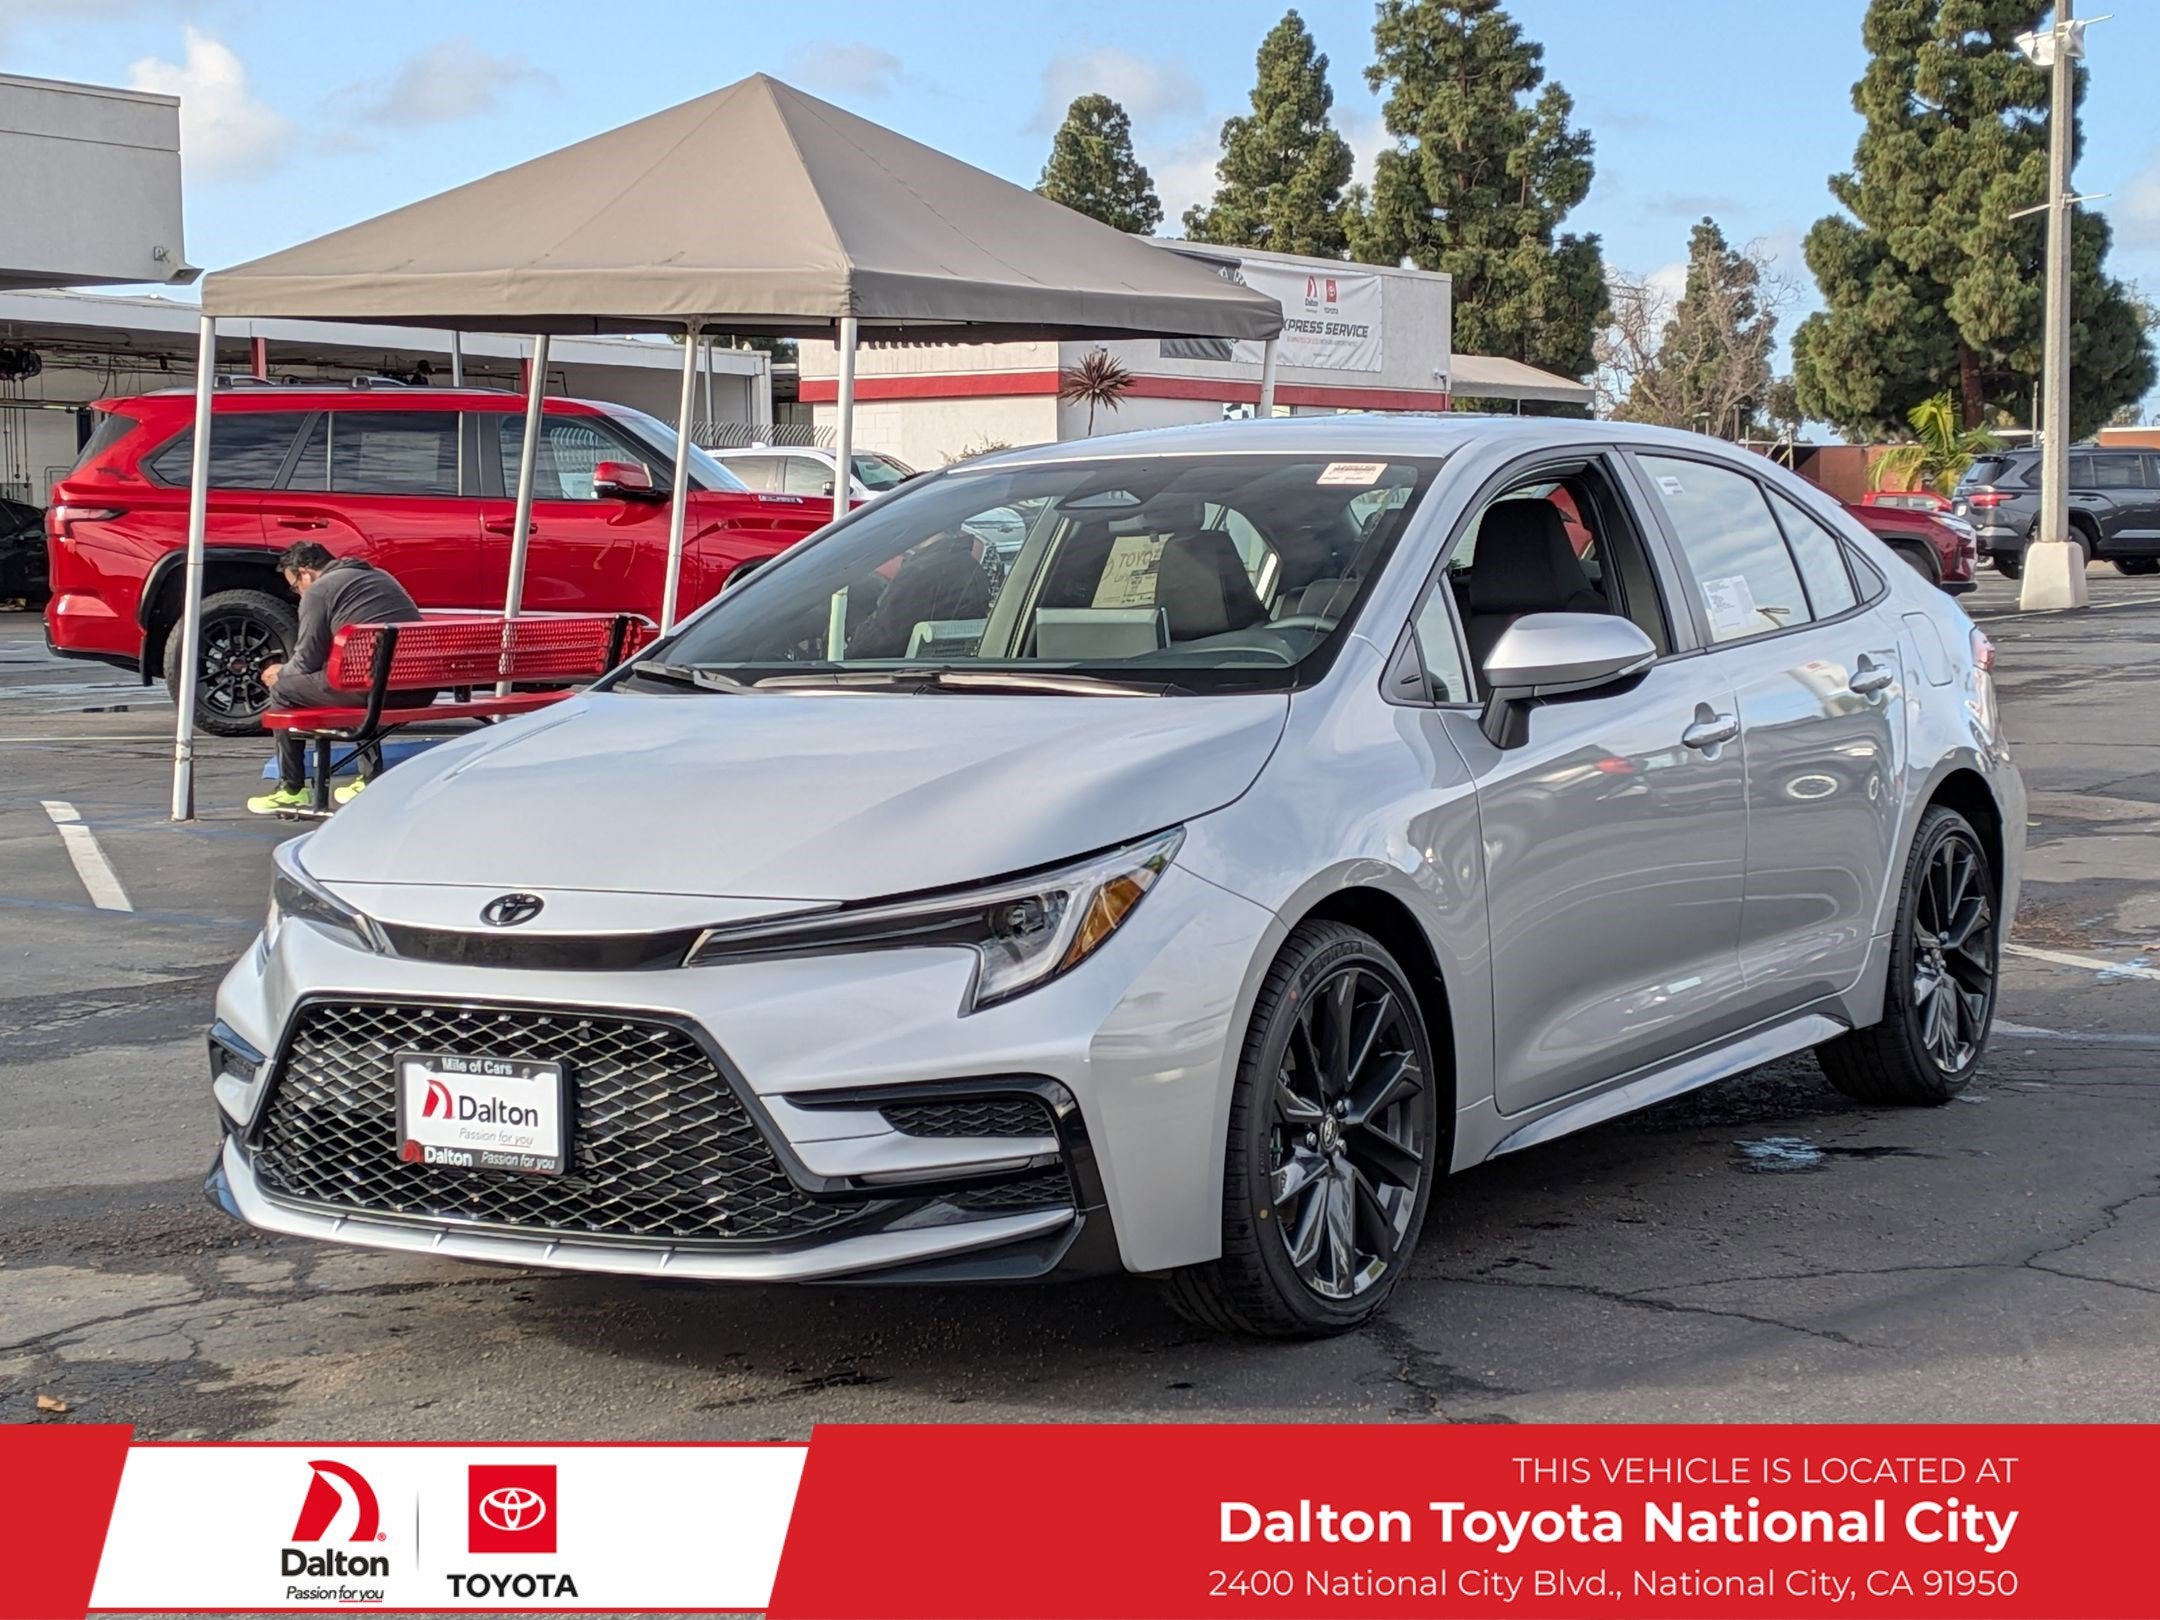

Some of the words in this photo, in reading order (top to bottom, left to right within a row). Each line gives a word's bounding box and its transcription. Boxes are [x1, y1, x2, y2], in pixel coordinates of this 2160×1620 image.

[1283, 318, 1324, 334] XPRESS
[1325, 322, 1369, 338] SERVICE
[1120, 550, 1158, 568] TOYO
[442, 1057, 467, 1073] Mile
[469, 1058, 483, 1073] of
[484, 1060, 513, 1075] Cars
[458, 1095, 539, 1127] Dalton
[459, 1128, 497, 1143] Passion
[498, 1130, 514, 1144] for
[514, 1133, 534, 1146] you
[424, 1146, 473, 1167] Dalton
[481, 1151, 519, 1167] Passion
[519, 1153, 536, 1168] for
[536, 1157, 556, 1170] you
